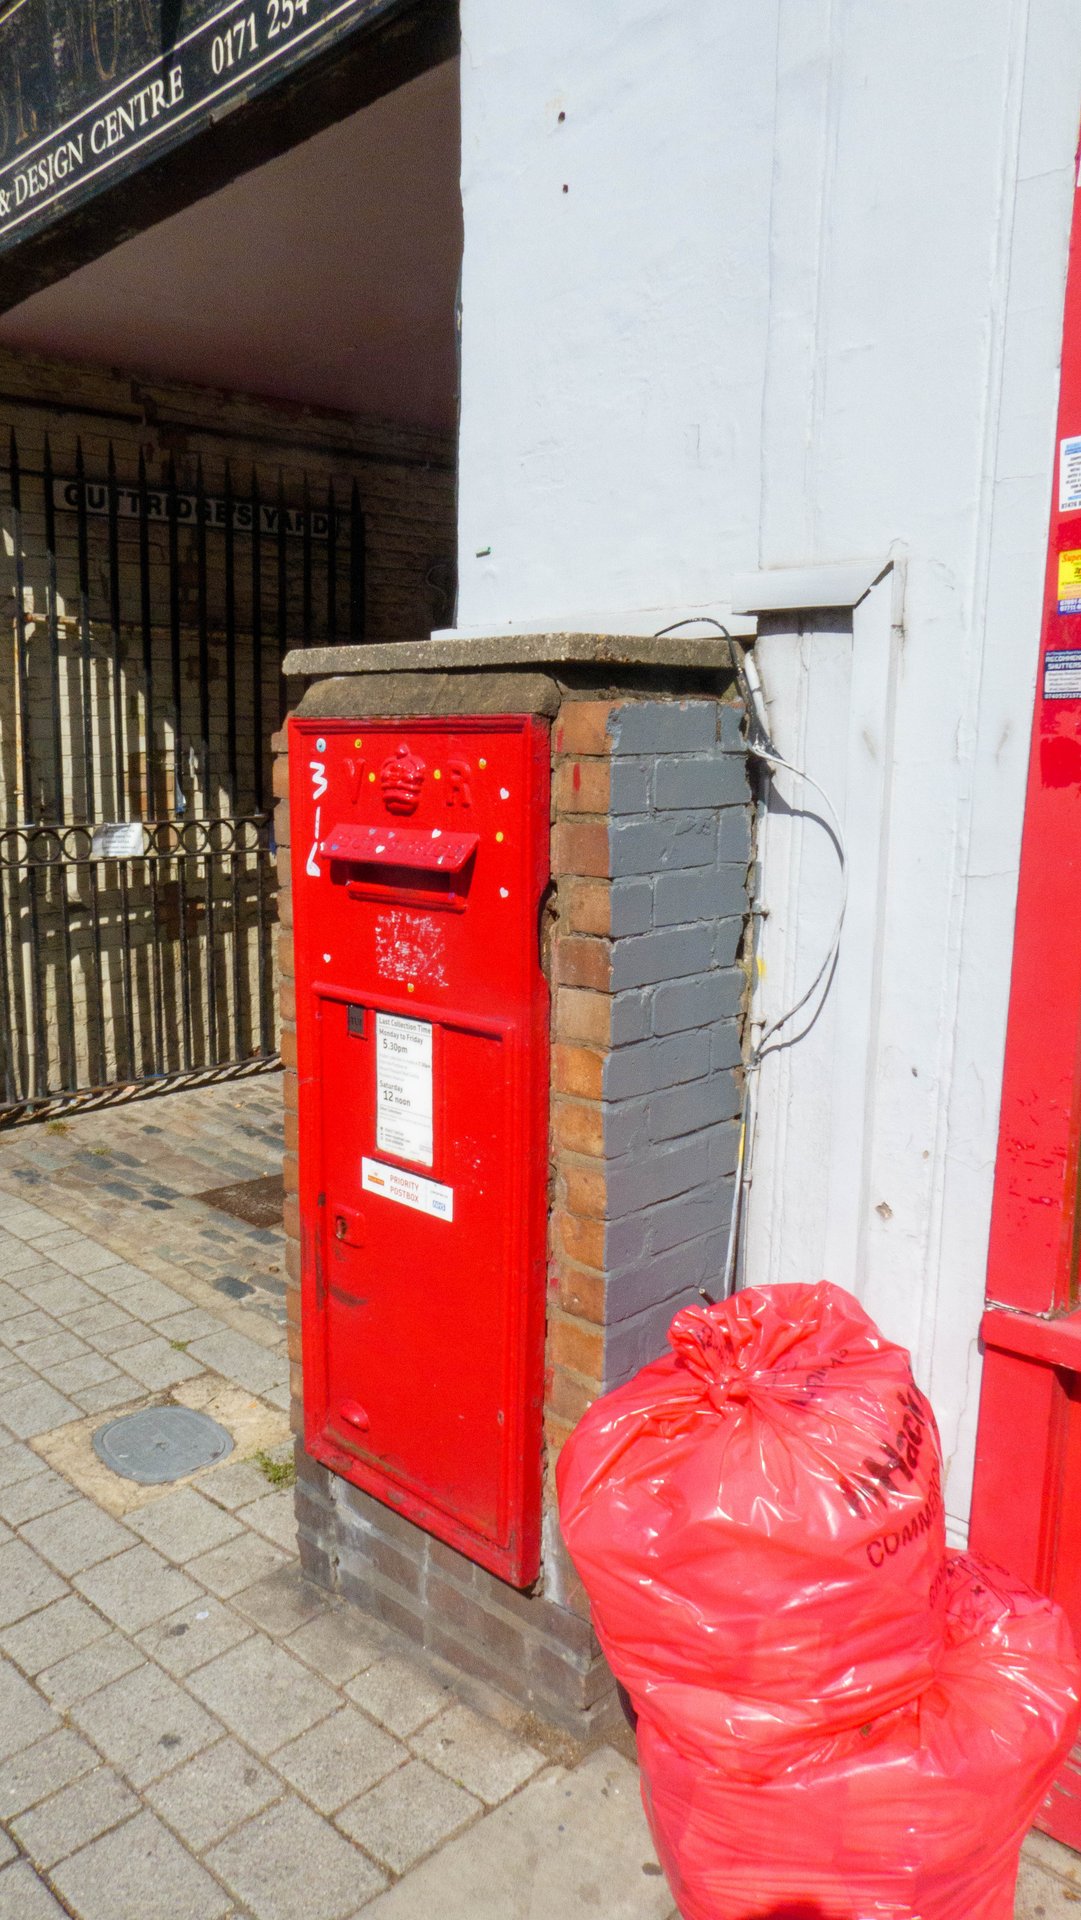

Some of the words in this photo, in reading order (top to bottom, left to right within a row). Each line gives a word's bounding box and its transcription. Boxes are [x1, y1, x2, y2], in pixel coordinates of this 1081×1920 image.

[13, 133, 84, 206] DESIGN
[90, 65, 185, 155] CENTRE
[211, 12, 259, 75] 0171
[379, 1016, 391, 1026] Last
[391, 1019, 417, 1031] Collection
[379, 1028, 400, 1040] Monday
[407, 1034, 424, 1045] Friday
[383, 1038, 408, 1053] 5.30pm
[379, 1079, 403, 1093] Saturday
[383, 1090, 394, 1102] 12
[395, 1097, 411, 1107] noon
[390, 1174, 420, 1191] PRIORITY
[390, 1186, 419, 1203] POSTBOX
[863, 1384, 925, 1492] Hack
